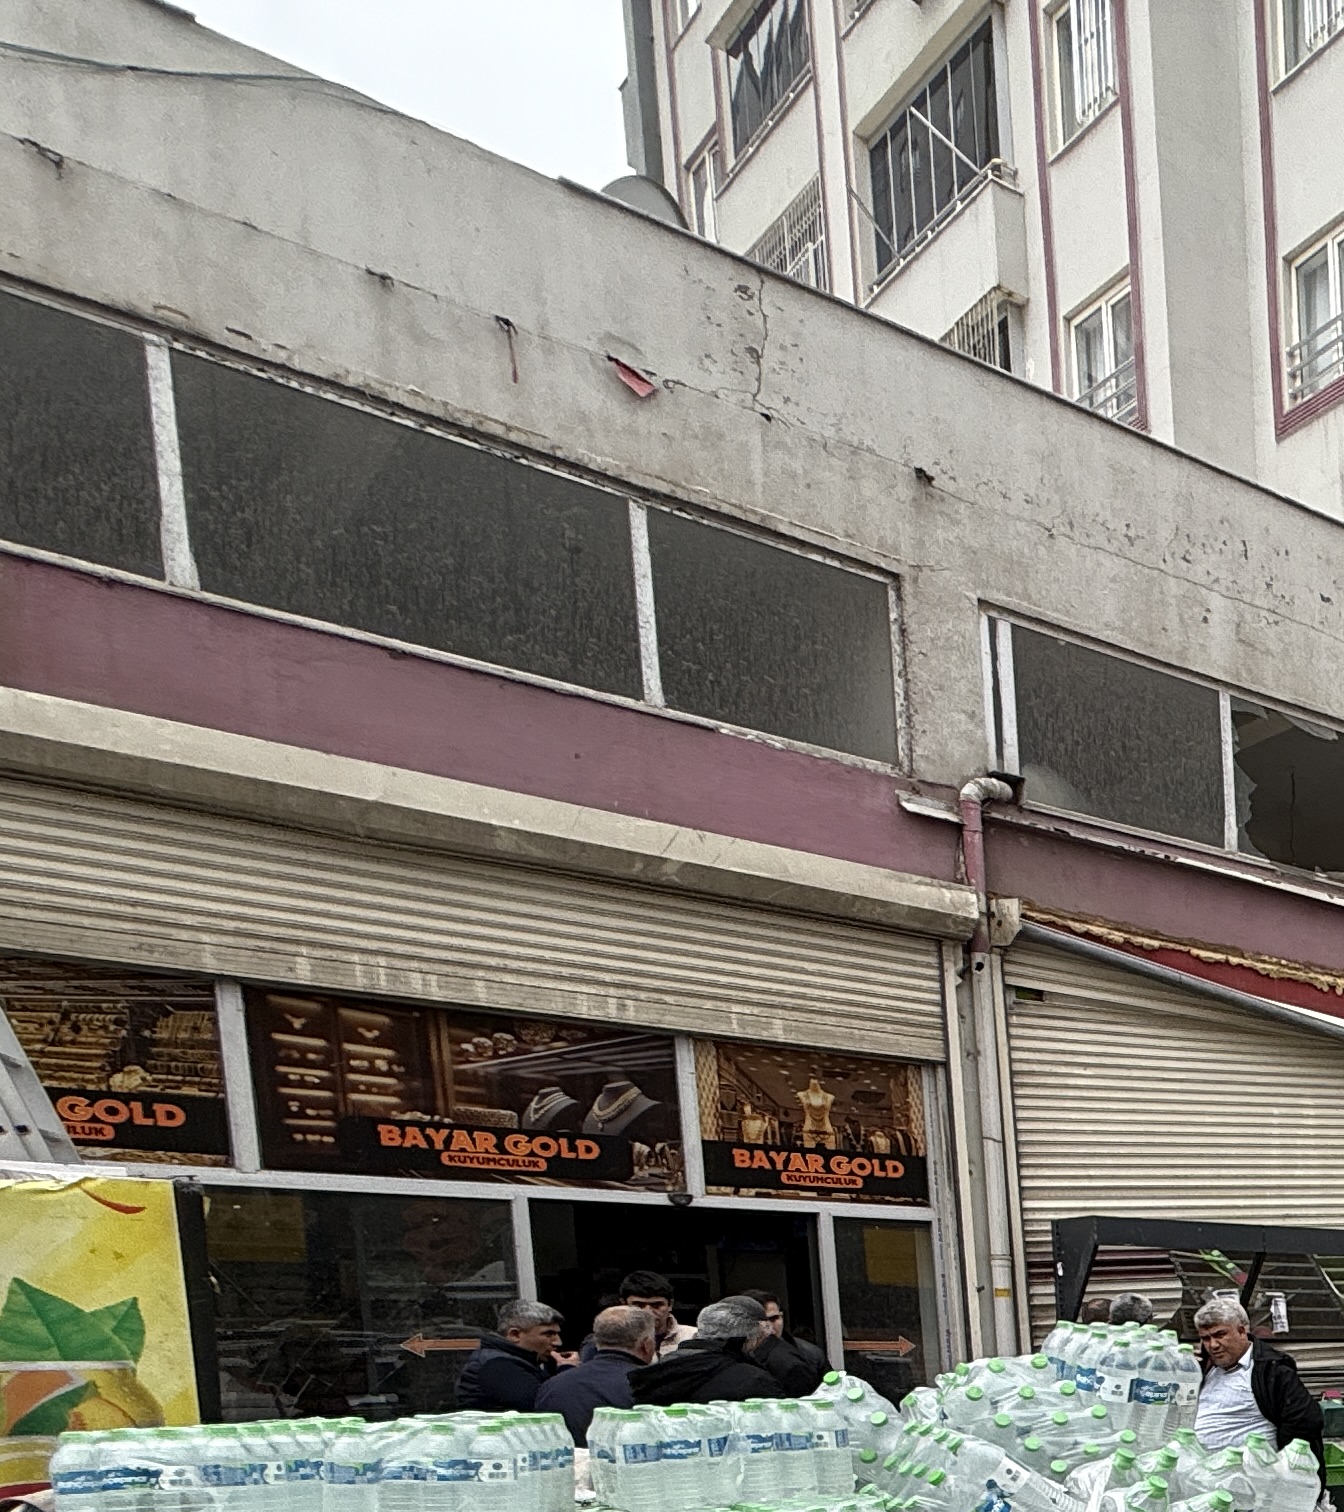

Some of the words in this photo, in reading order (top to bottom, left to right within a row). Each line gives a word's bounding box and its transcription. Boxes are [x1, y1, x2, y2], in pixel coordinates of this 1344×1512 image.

[56, 1095, 187, 1128] GOLD
[377, 1124, 500, 1154] BAYAR
[504, 1133, 601, 1160] GOLD
[447, 1154, 541, 1169] KUYUMCULUK
[732, 1148, 826, 1173] BAYAR
[830, 1155, 905, 1178] GOLD
[785, 1173, 859, 1187] KUYUMCULUK
